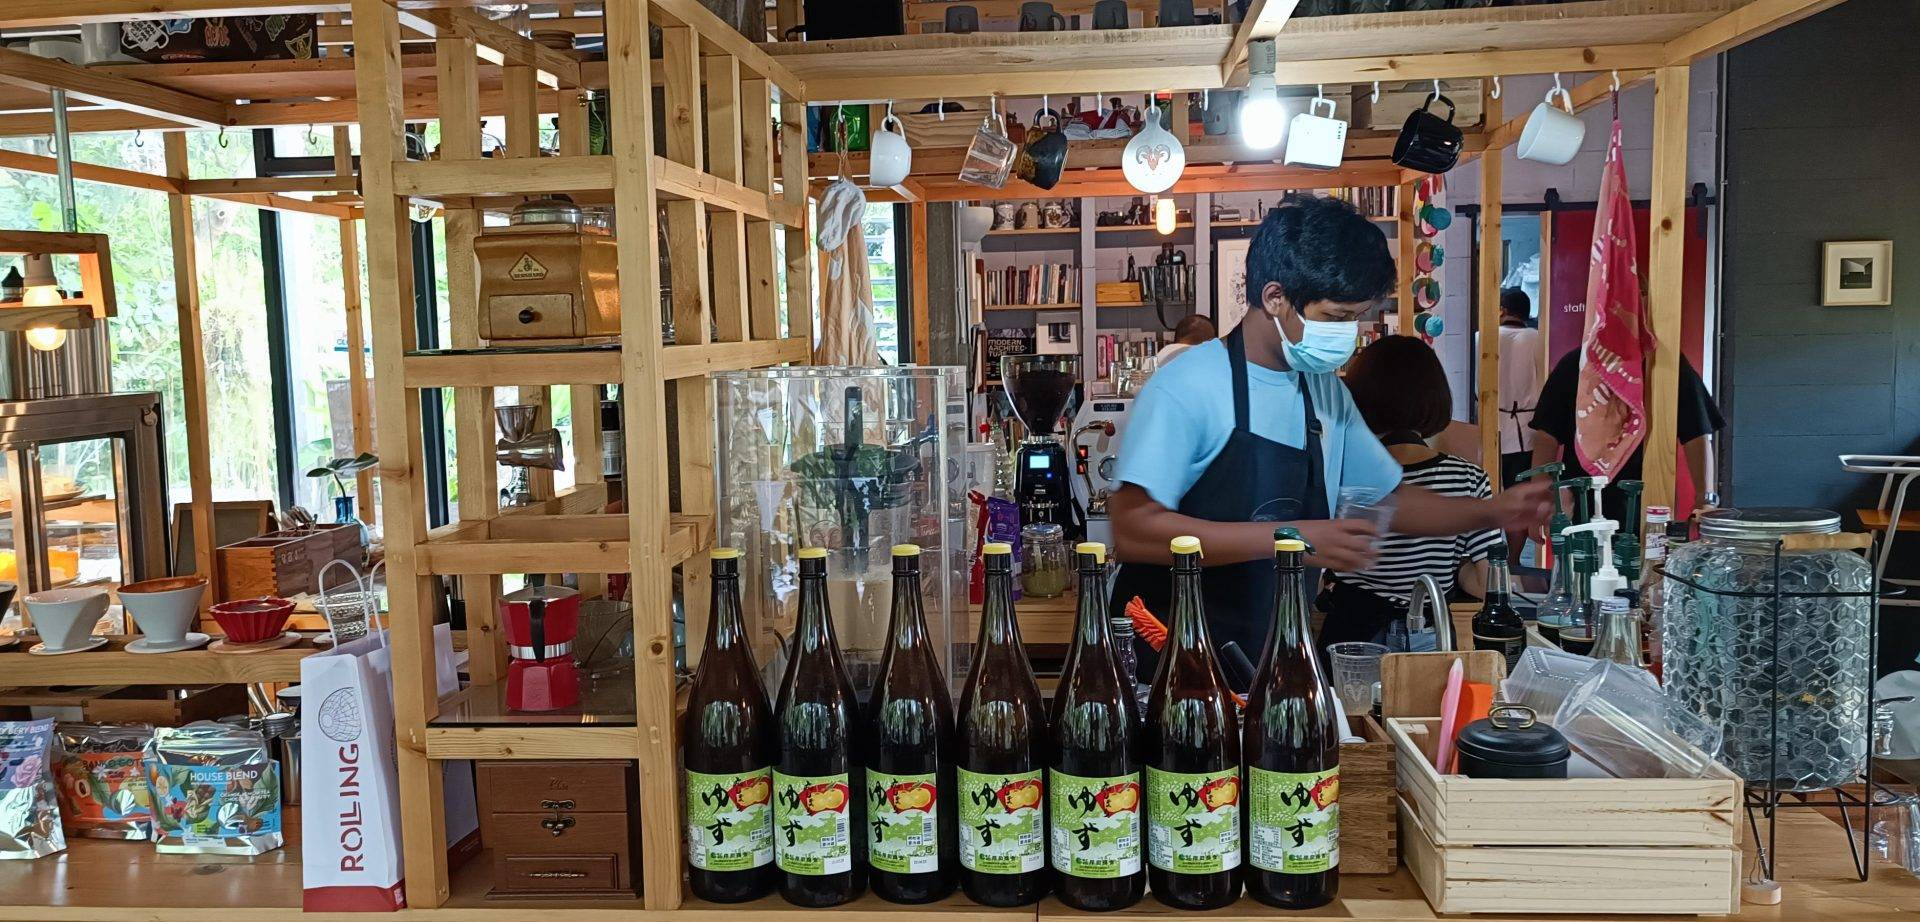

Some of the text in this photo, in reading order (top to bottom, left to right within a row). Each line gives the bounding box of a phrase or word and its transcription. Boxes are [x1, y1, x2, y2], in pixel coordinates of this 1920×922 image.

[190, 770, 258, 782] HOUSE BLEND
[338, 743, 365, 872] ROLLING
